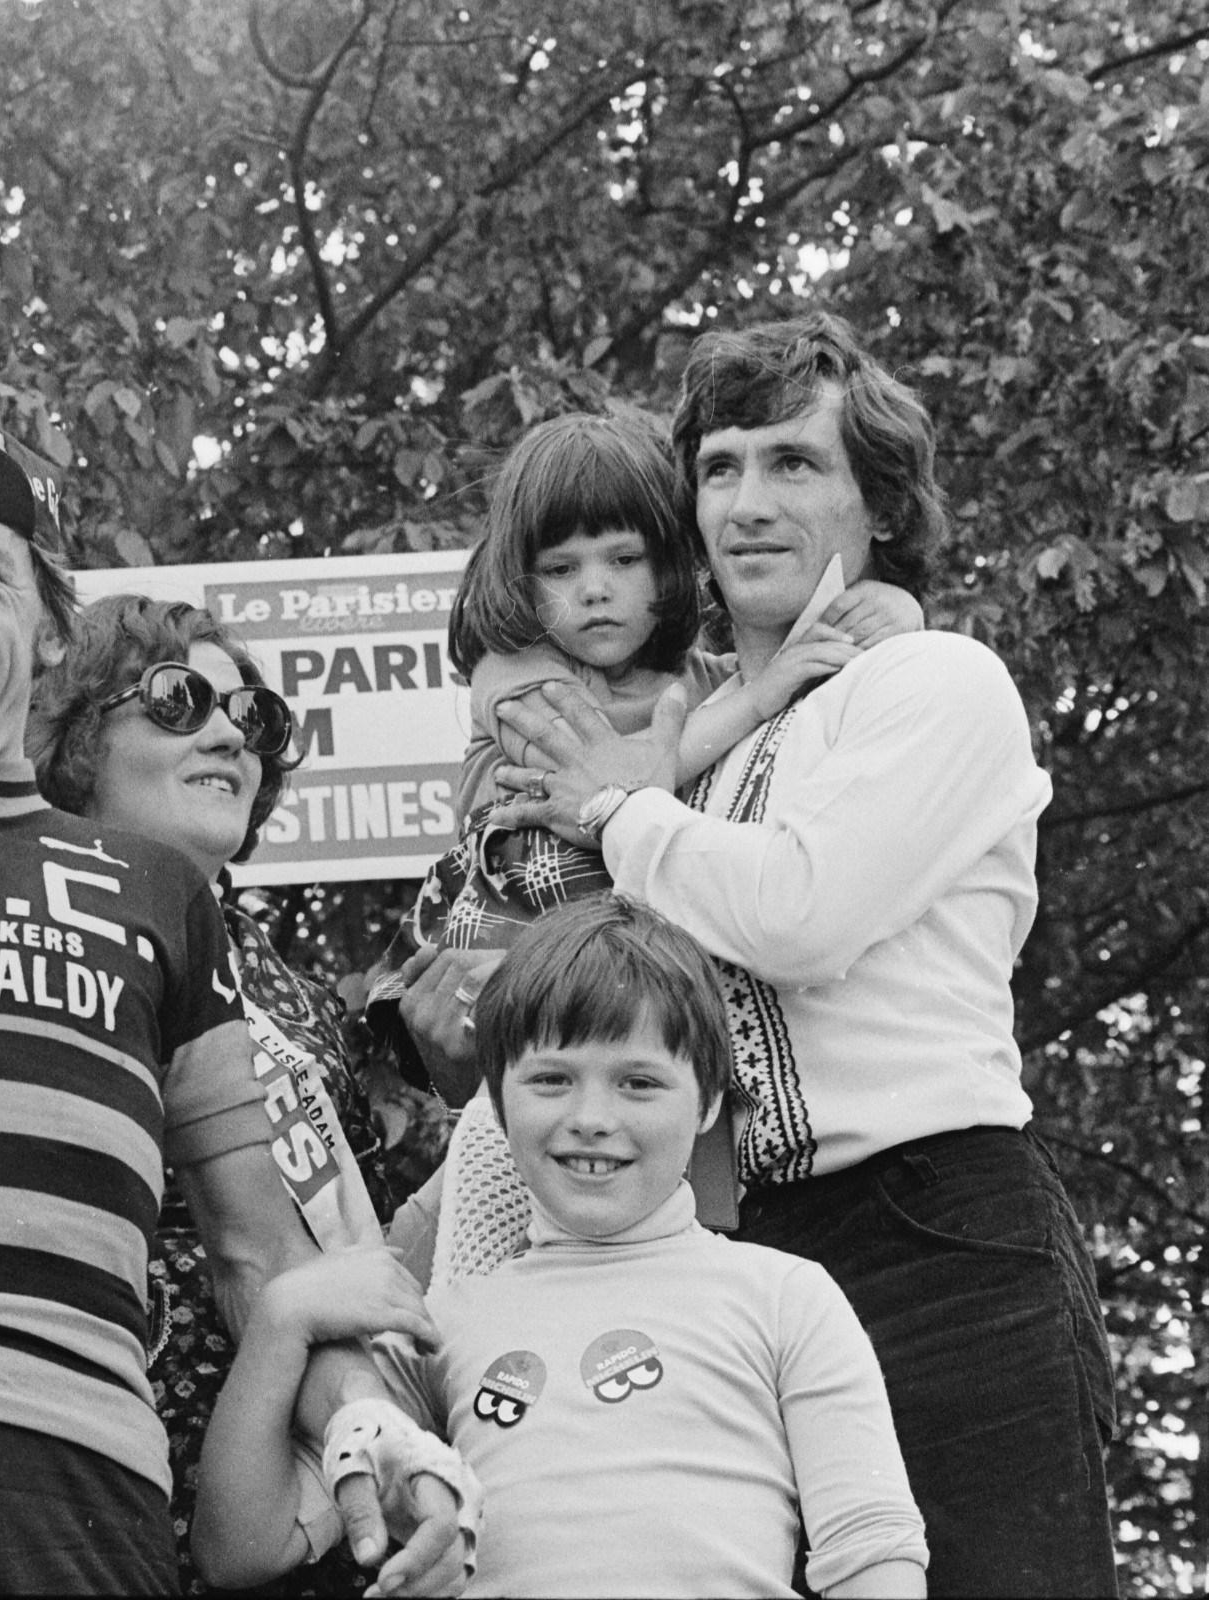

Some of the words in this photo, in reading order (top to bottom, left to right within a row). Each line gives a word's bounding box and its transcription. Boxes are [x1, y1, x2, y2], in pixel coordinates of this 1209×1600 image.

[218, 593, 271, 624] Le
[281, 643, 470, 697] PARI
[259, 780, 455, 843] STINES
[259, 1035, 336, 1149] L'ISLE-ADAM
[596, 1346, 637, 1371] RAPIDO
[496, 1371, 529, 1389] RAPIDO
